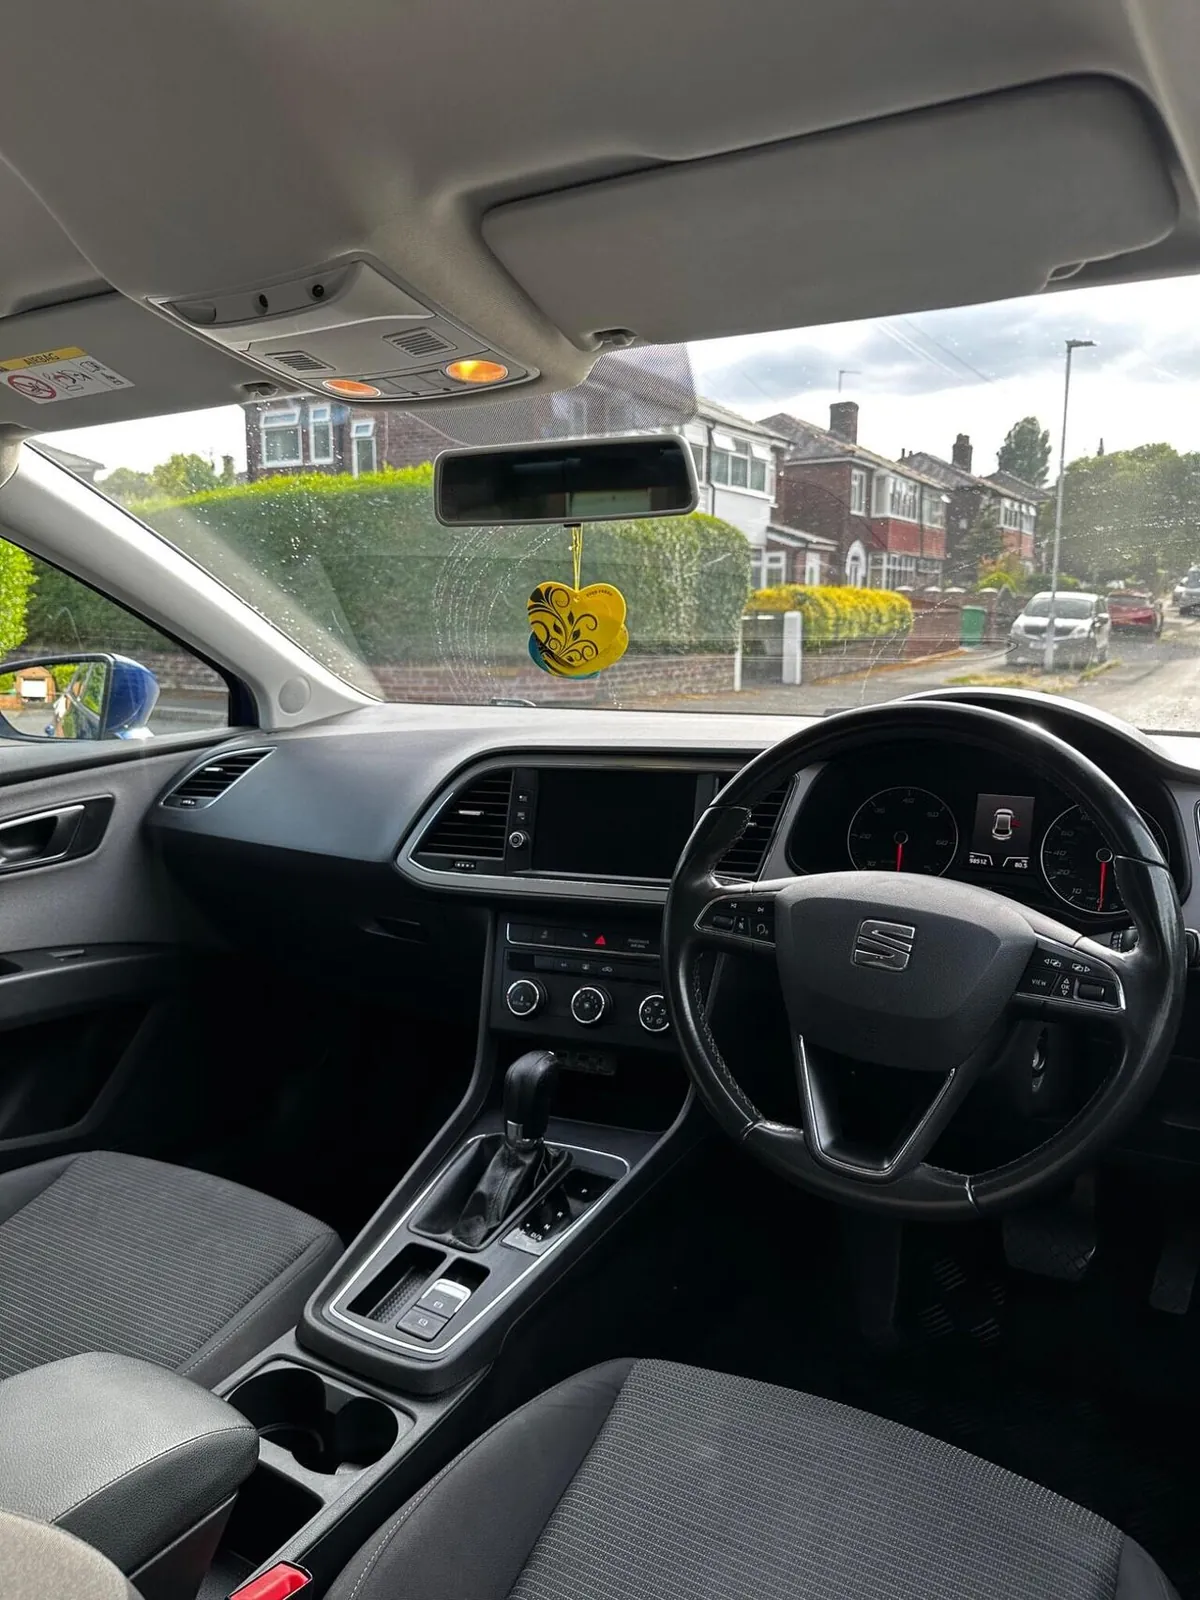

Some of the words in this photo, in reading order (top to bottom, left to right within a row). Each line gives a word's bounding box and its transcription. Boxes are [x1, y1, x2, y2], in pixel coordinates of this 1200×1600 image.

[23, 352, 60, 366] AIRBAG
[1053, 849, 1067, 857] 40
[1056, 868, 1071, 876] 20
[1072, 886, 1083, 895] 10
[1031, 977, 1047, 987] VIEW
[1060, 983, 1070, 991] OK
